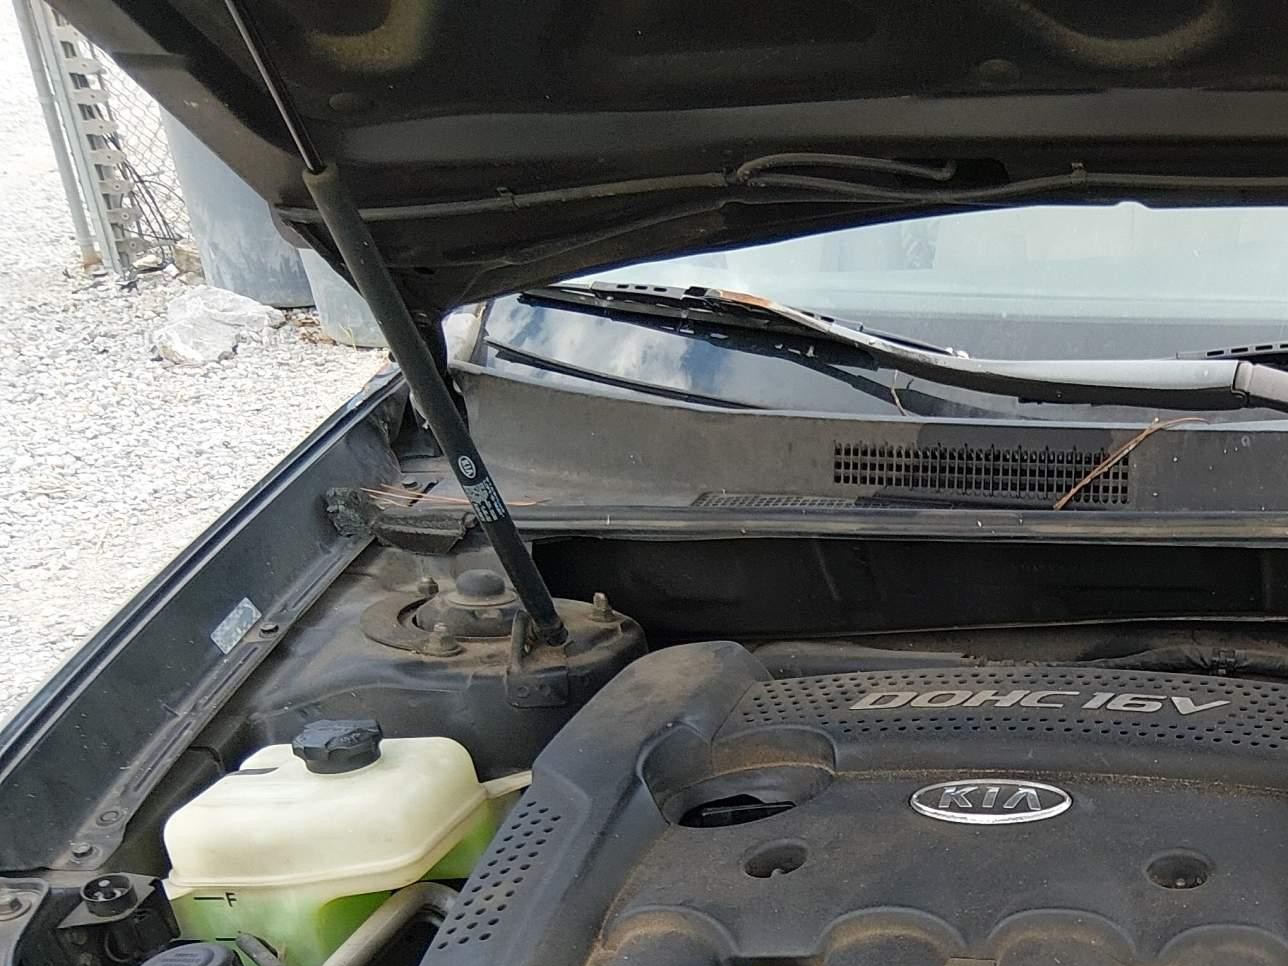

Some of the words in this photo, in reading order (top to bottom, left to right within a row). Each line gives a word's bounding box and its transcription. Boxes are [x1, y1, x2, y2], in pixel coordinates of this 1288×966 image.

[850, 690, 1080, 711] DOHC
[1082, 692, 1231, 716] 16V
[938, 786, 1041, 811] KIA
[225, 892, 237, 907] F
